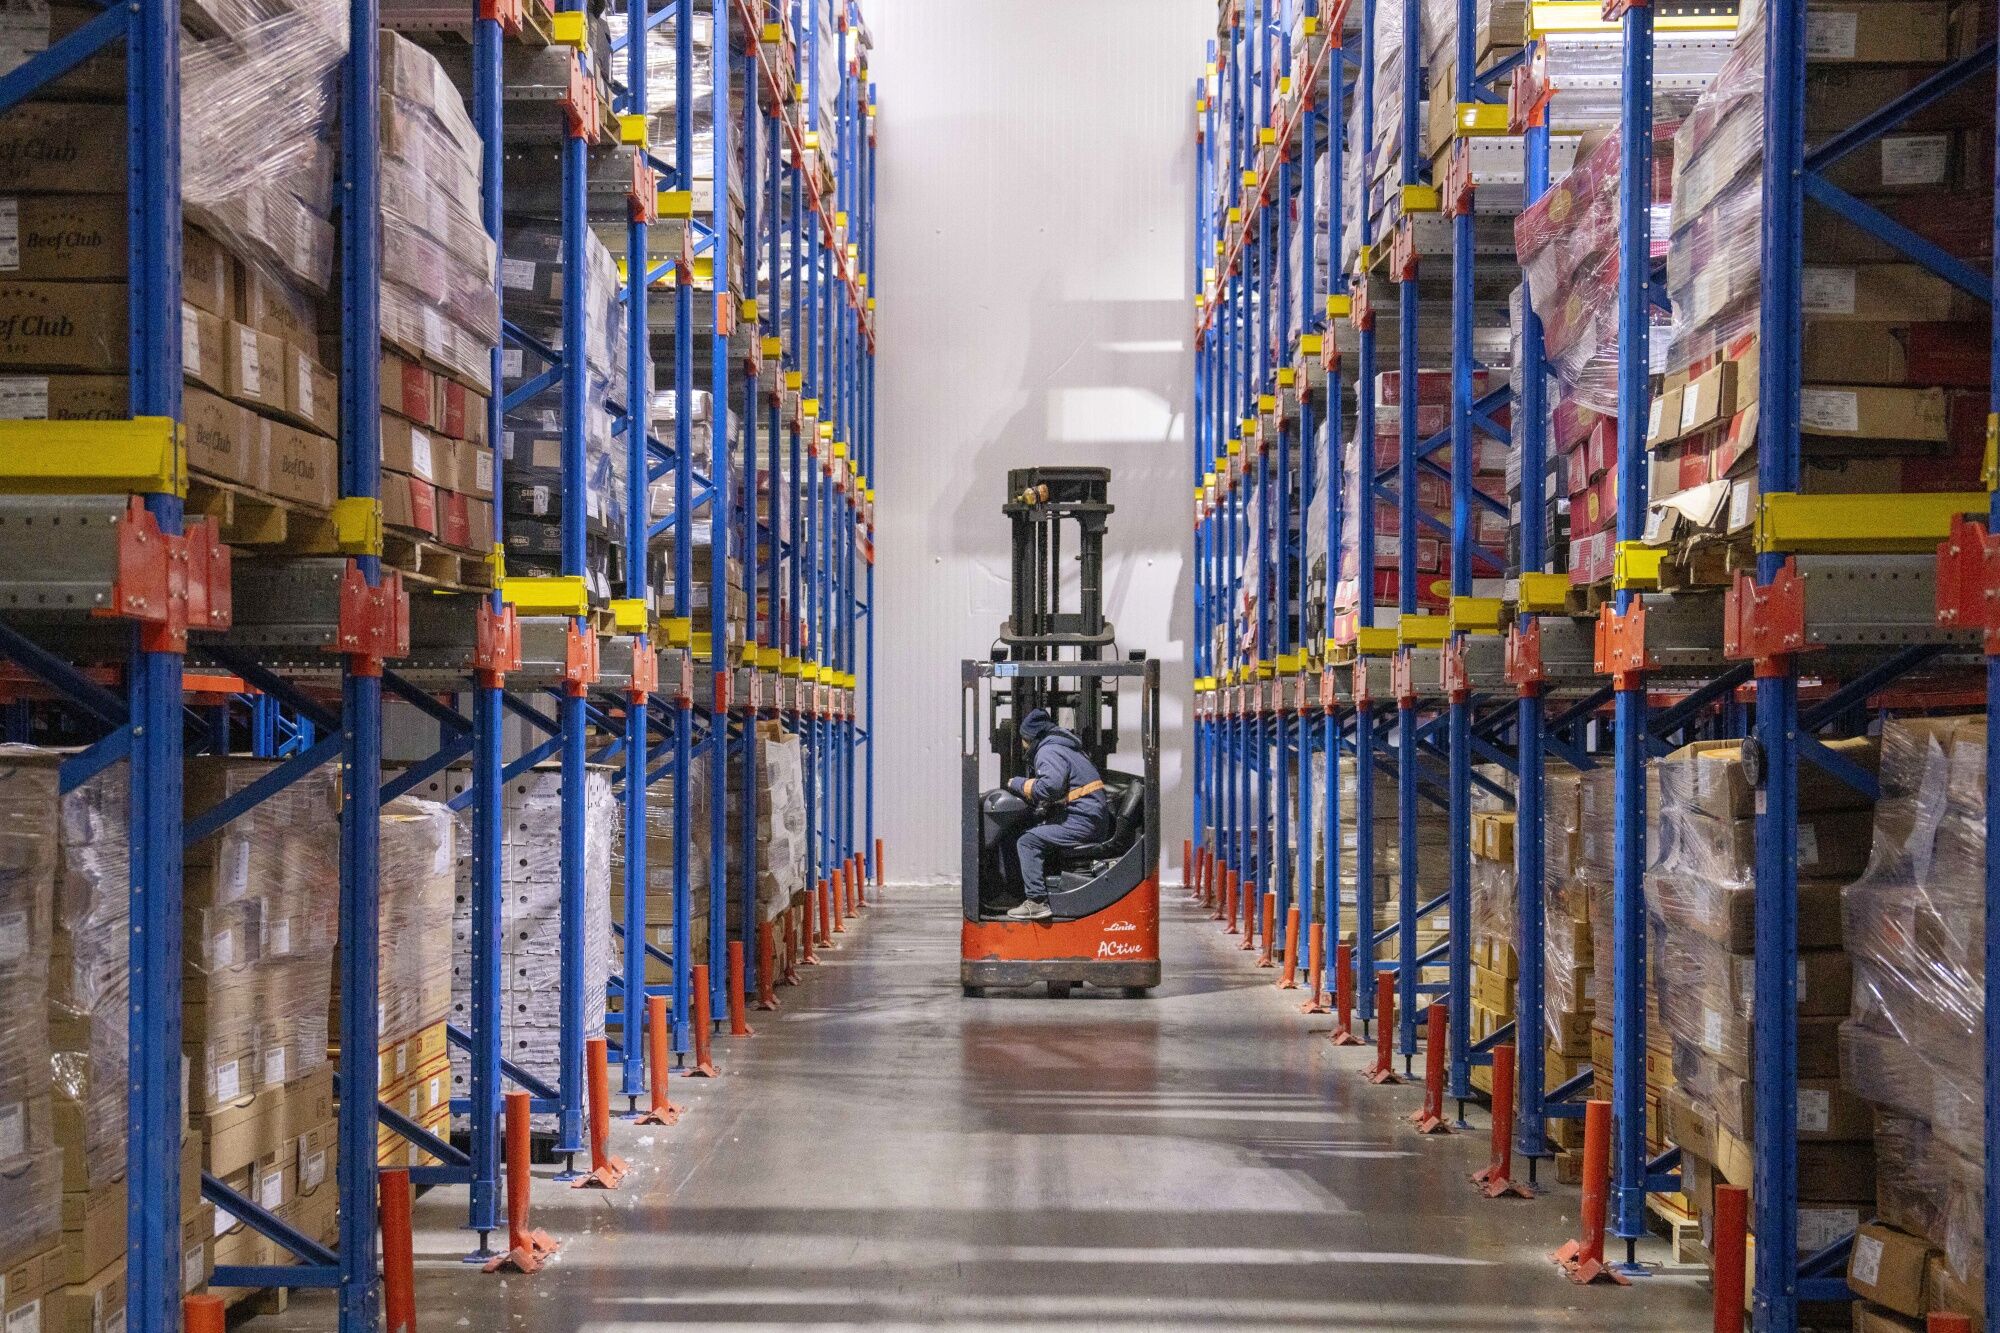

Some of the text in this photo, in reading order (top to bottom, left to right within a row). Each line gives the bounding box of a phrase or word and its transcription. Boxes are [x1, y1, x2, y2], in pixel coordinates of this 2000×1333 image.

[26, 230, 103, 250] Beef Club
[0, 313, 75, 342] ef Club
[196, 423, 232, 454] Beef Club
[282, 454, 316, 480] Beef Club
[1103, 920, 1137, 932] Linde
[1097, 940, 1143, 957] ACtive
